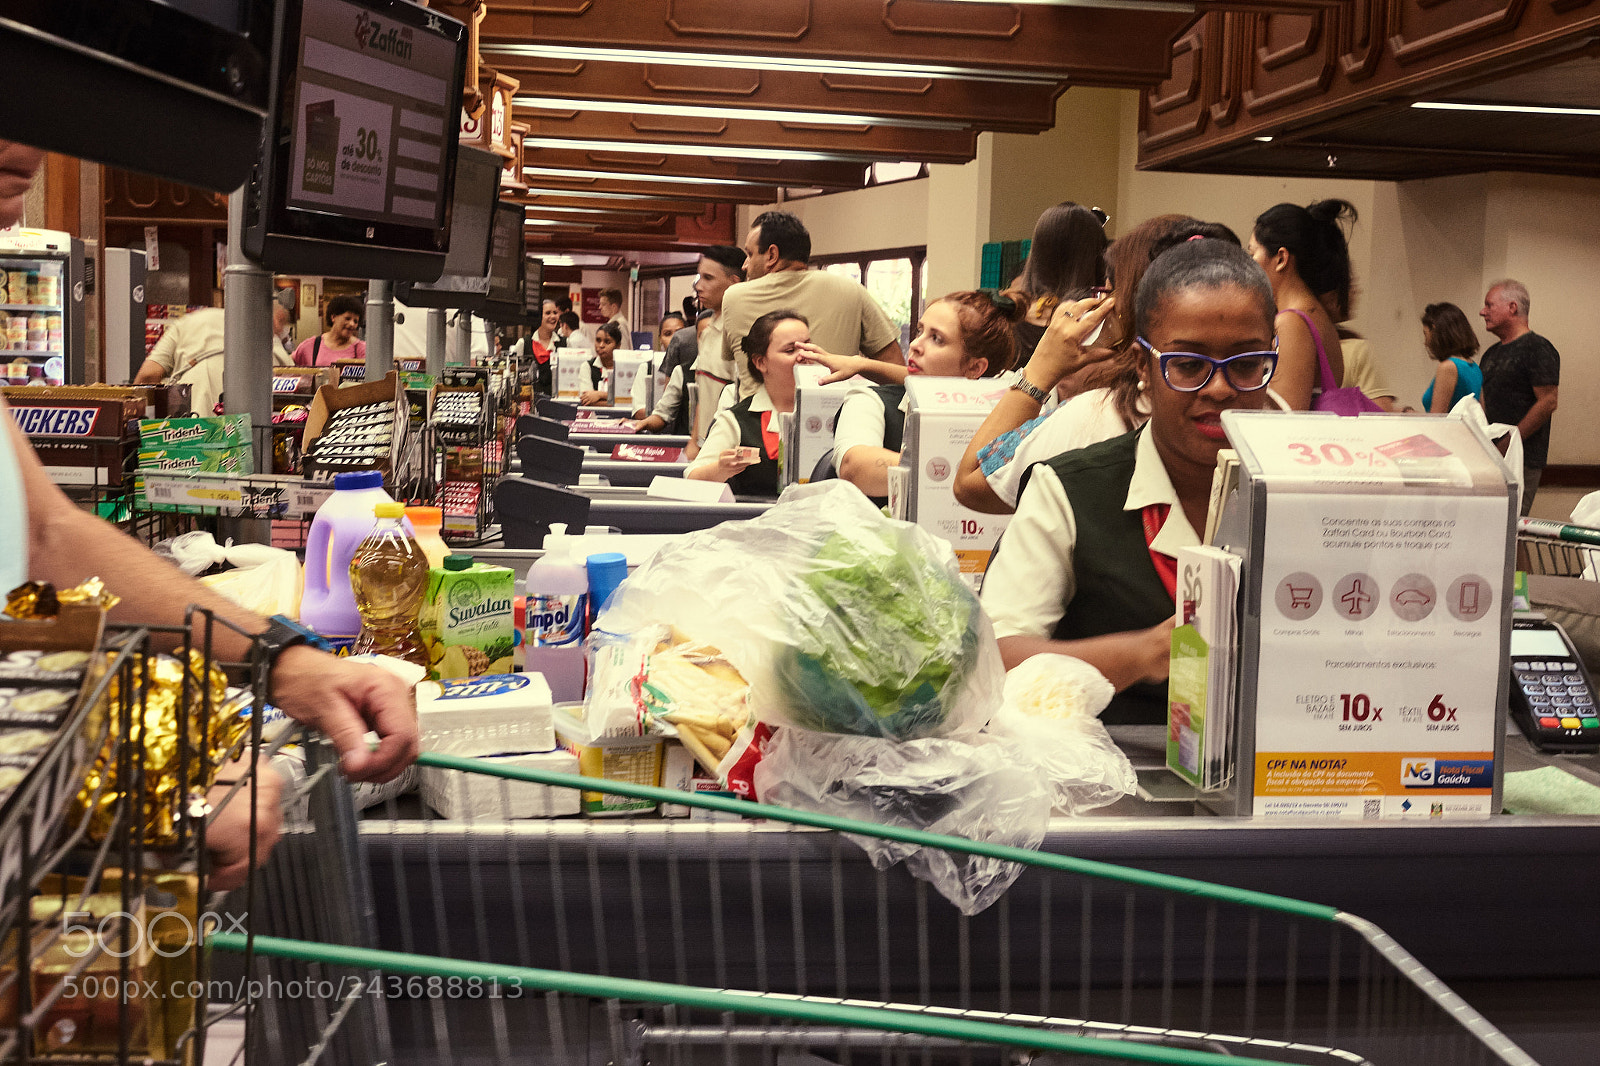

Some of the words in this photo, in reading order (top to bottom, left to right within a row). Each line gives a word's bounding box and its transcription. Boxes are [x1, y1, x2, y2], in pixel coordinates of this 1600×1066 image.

[369, 20, 413, 61] Zaffari
[352, 162, 383, 177] desconto
[163, 426, 201, 441] Trident
[1288, 443, 1387, 467] 30%
[159, 456, 197, 470] Trident
[241, 492, 278, 507] Trident
[1322, 516, 1369, 526] Concentre
[1403, 519, 1442, 528] compras
[1352, 528, 1374, 537] Card
[448, 599, 512, 628] Suvalan
[1325, 659, 1391, 669] Parcelamentos
[1266, 760, 1288, 770] CPF
[1290, 760, 1307, 770] NA
[1309, 759, 1347, 770] NOTA?
[1404, 762, 1432, 781] NFG
[1440, 766, 1462, 774] Nota
[1462, 765, 1485, 775] Fiscal
[1336, 770, 1374, 778] documento
[1437, 774, 1471, 785] Gaúcha
